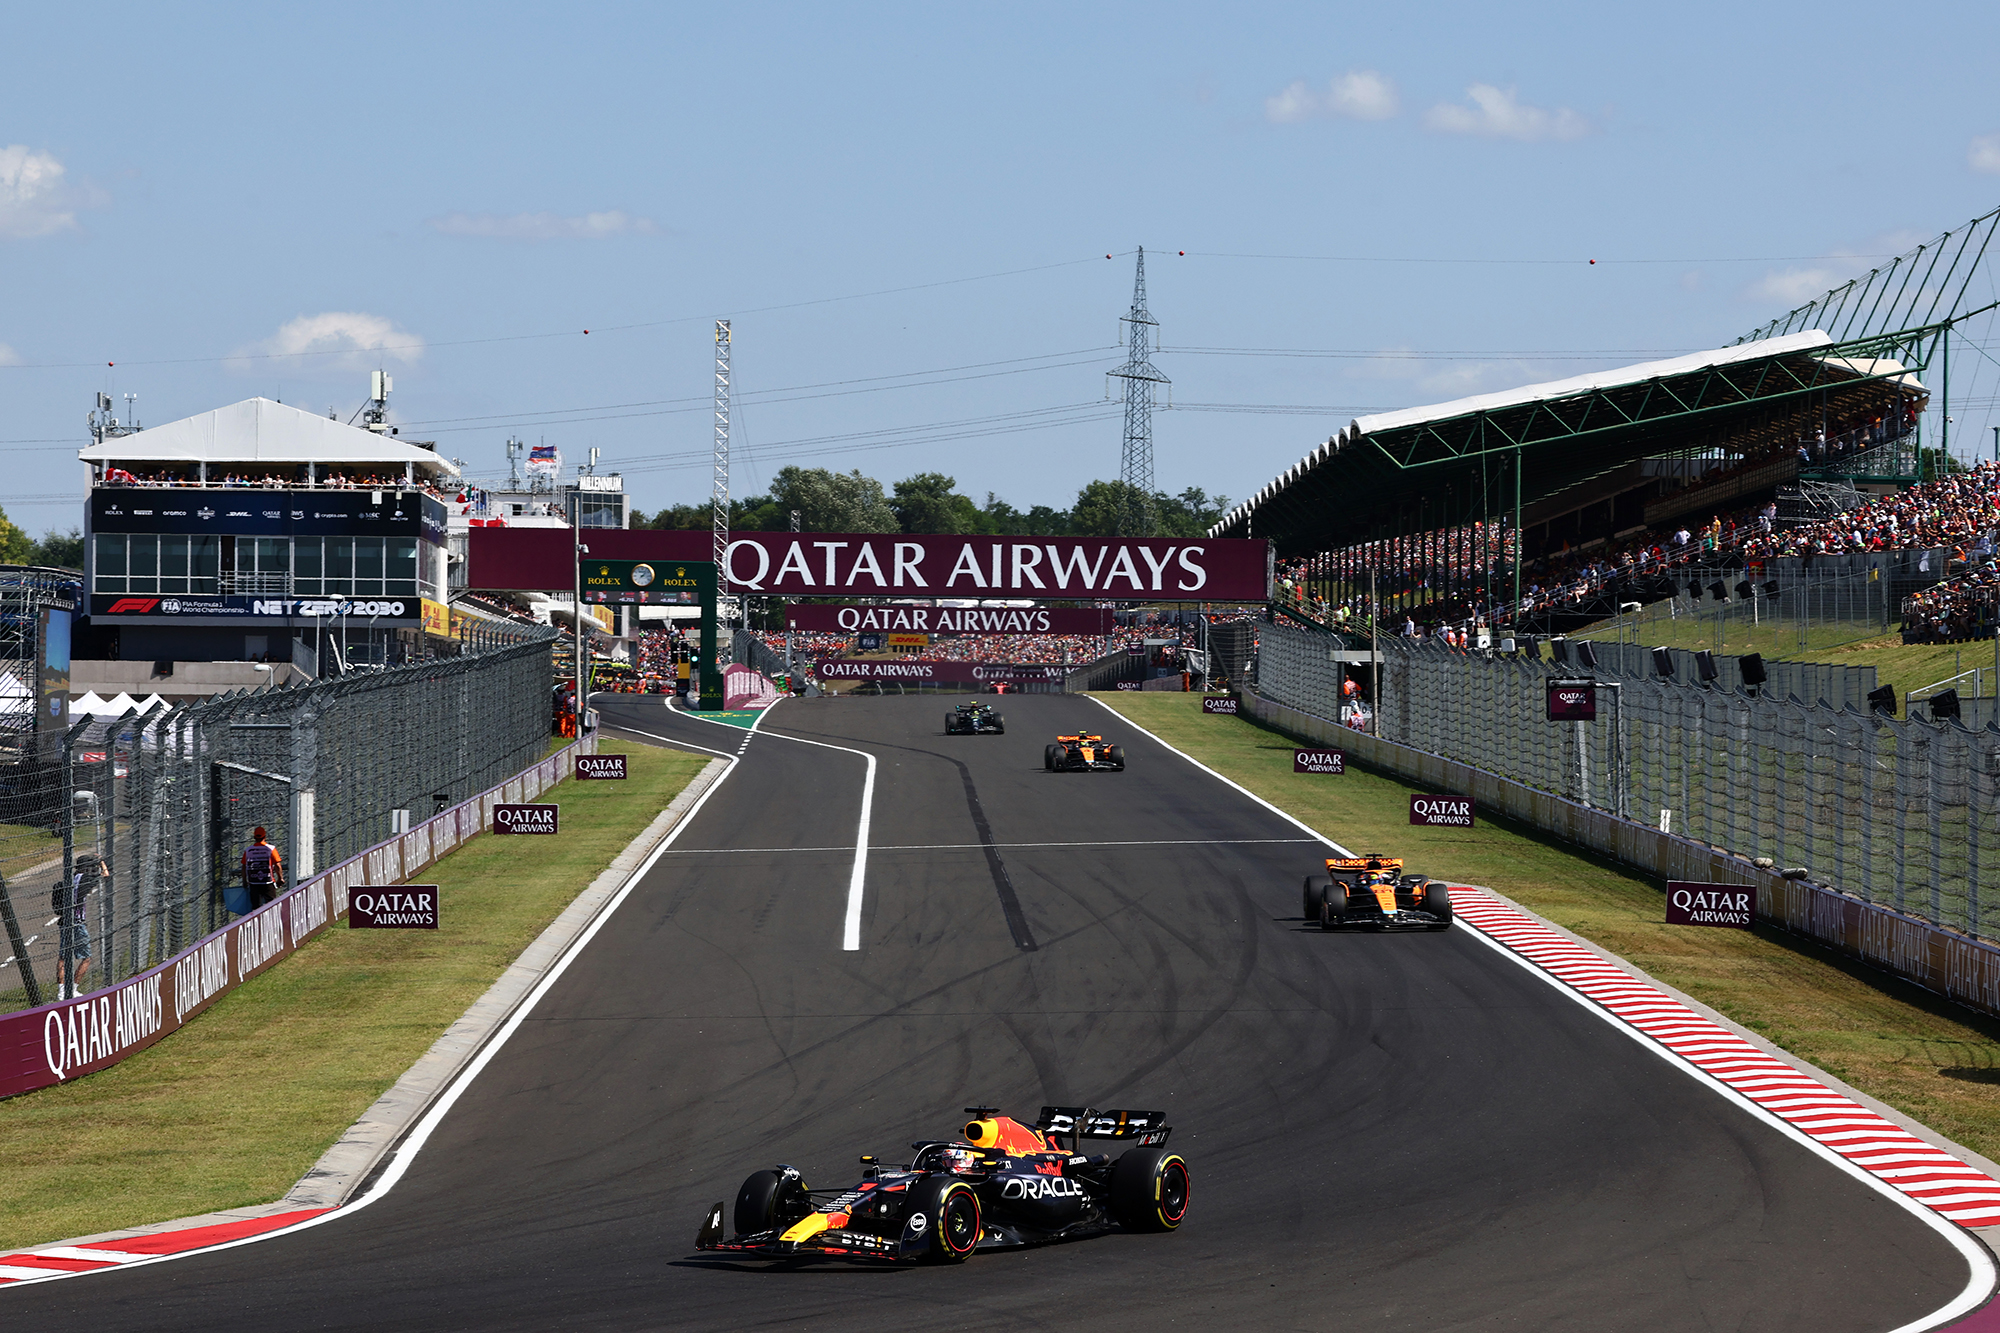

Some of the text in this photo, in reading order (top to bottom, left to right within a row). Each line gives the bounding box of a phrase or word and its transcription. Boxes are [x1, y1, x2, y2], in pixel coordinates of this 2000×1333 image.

[580, 476, 622, 490] MILLENNIUM
[726, 539, 1207, 591] QATAR AIRWAYS
[587, 577, 621, 586] ROLEX
[664, 579, 698, 587] ROLEX
[162, 600, 181, 611] FIA
[253, 600, 295, 615] NET
[353, 600, 405, 616] 2030
[837, 608, 1050, 631] QATAR AIRWAYS
[822, 663, 933, 678] QATAR AIRWAYS
[1204, 699, 1237, 709] QATAR
[578, 759, 623, 772] QATAR
[1297, 752, 1342, 766] QATAR
[588, 770, 624, 778] AIRWAYS
[1306, 764, 1342, 774] AIRWAYS
[1413, 799, 1470, 817] QATAR
[497, 809, 554, 826] QATAR
[1426, 814, 1470, 826] AIRWAYS
[510, 823, 554, 833] AIRWAYS
[355, 893, 433, 916] QATAR
[1672, 889, 1750, 912] QATAR
[373, 912, 433, 925] AIRWAYS
[1689, 910, 1750, 925] AIRWAYS
[1858, 906, 1889, 964] QATAR
[1944, 938, 1980, 1003] QATAR
[175, 950, 200, 1024] QATAR
[44, 972, 162, 1080] QATAR AIRWAYS
[1001, 1177, 1083, 1199] ORACLE
